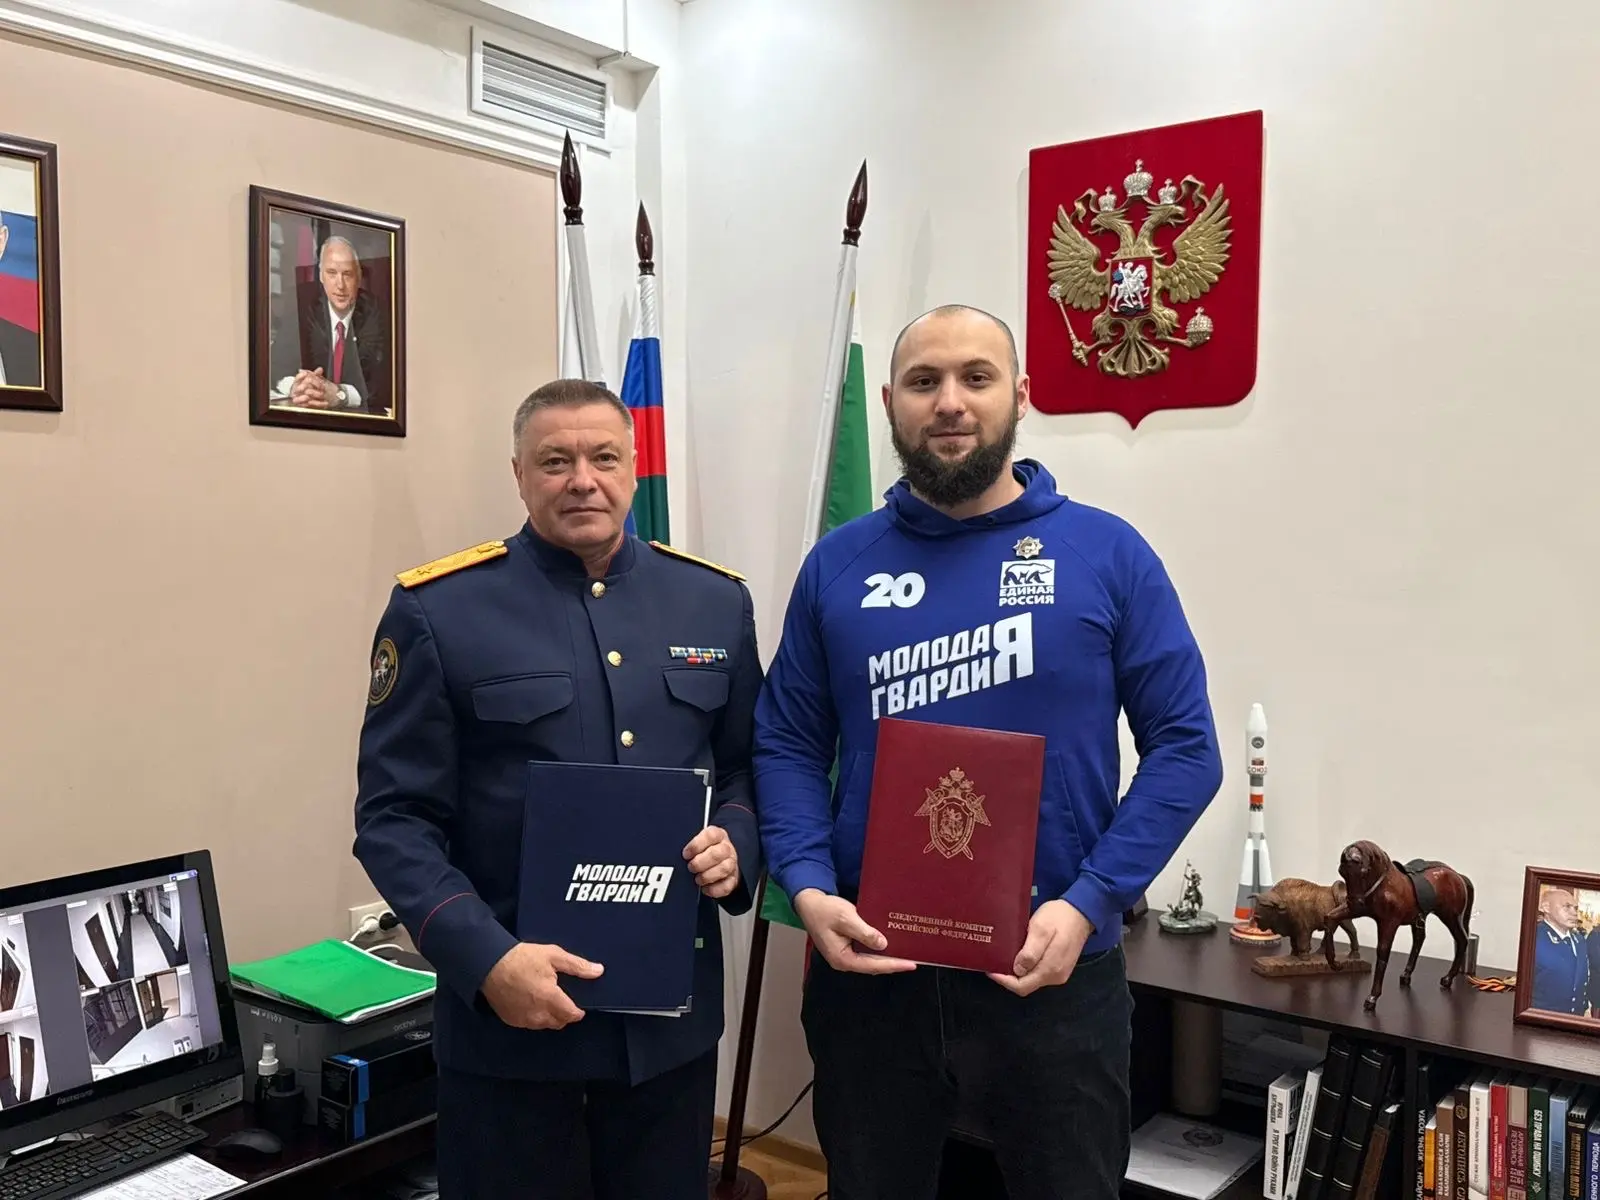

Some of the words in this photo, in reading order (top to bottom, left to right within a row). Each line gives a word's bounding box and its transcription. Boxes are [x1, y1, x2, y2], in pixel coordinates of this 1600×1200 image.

[861, 571, 926, 609] 20
[999, 585, 1055, 597] ЕДИНАЯ
[999, 595, 1055, 607] РОССИЯ
[887, 921, 940, 935] РОССИЙСКОЙ
[941, 930, 992, 943] ФЕДЕРАЦИИ
[888, 911, 953, 927] СЛЕДСТВЕННЫЙ
[955, 921, 994, 933] КОМИТЕТ
[1418, 1109, 1426, 1134] ПОЭТА
[1533, 1109, 1543, 1121] БЕЗ
[1533, 1121, 1543, 1141] ПРАВА
[1417, 1136, 1425, 1162] ЖИЗНЬ
[1456, 1130, 1467, 1183] ЛЕТОПИСЬ
[1510, 1130, 1518, 1165] ЛЕТОПИСЬ
[1533, 1141, 1542, 1150] НА
[1532, 1150, 1542, 1178] ОШИБКУ
[1591, 1142, 1600, 1173] ПЕРИОДА
